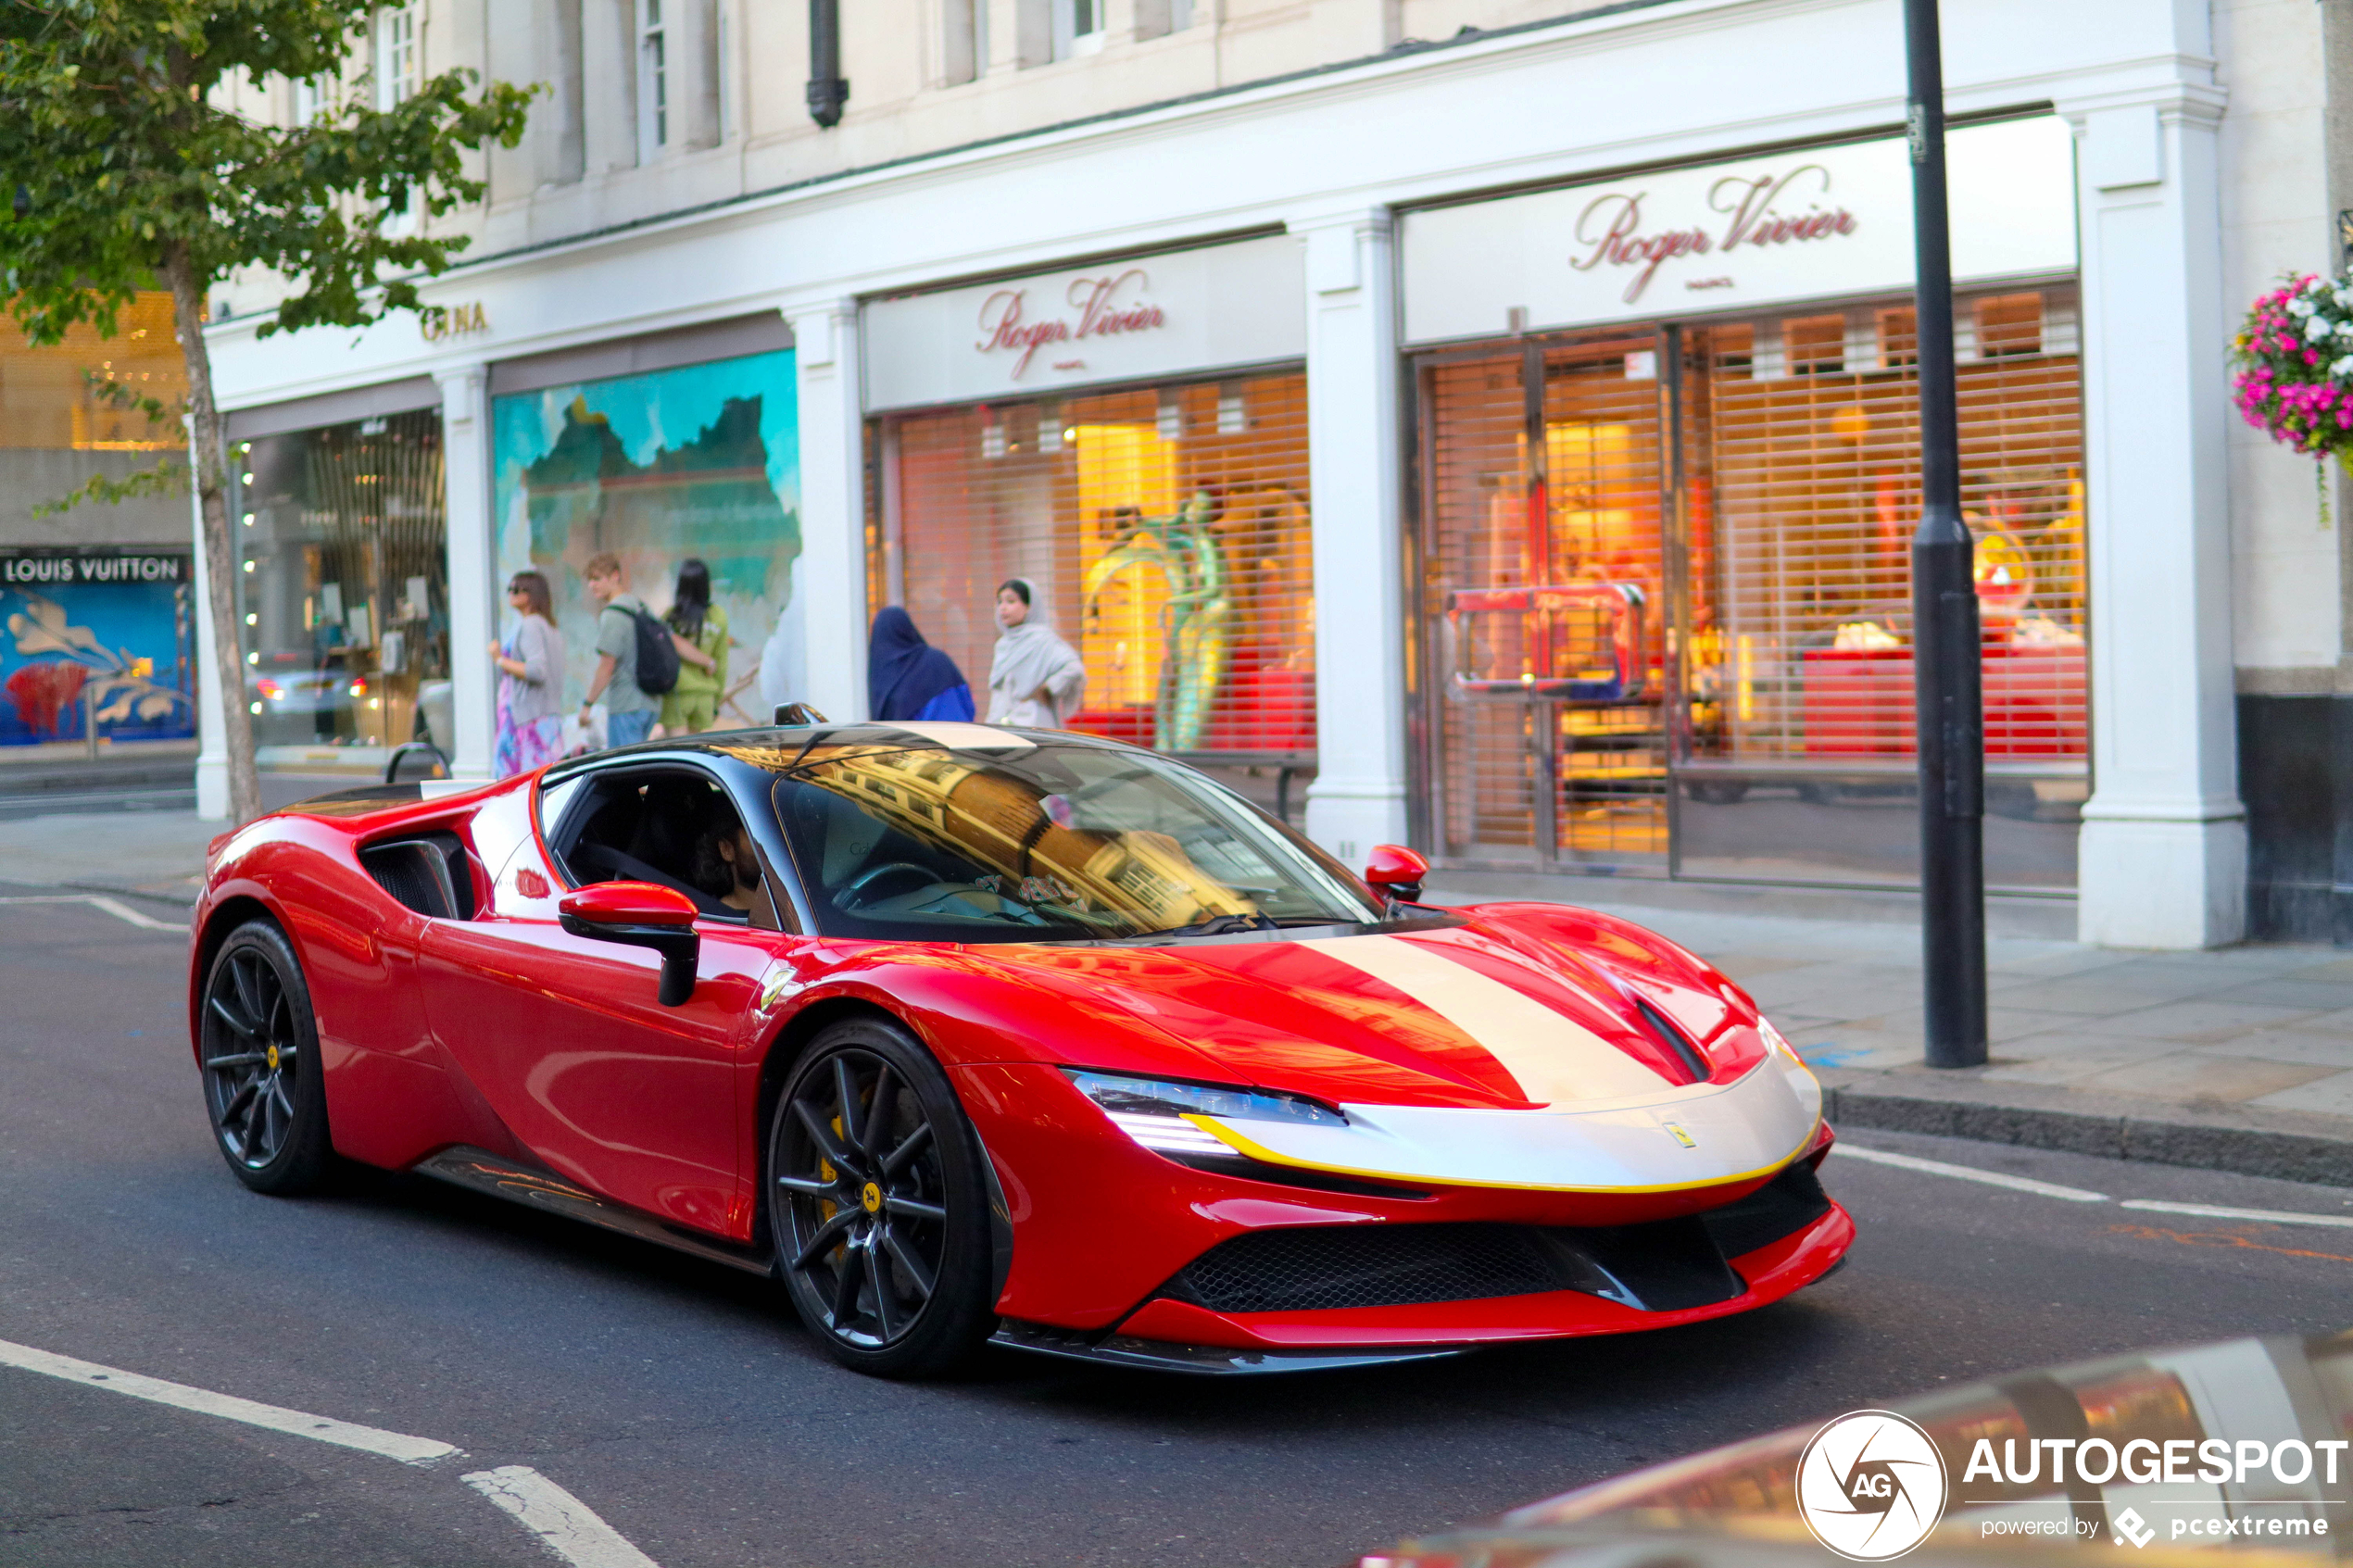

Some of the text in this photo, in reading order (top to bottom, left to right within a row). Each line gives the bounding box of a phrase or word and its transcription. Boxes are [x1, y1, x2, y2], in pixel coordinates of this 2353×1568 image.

[1568, 164, 1857, 304] Roger Vivier
[975, 268, 1165, 380] Roger Vivier
[5, 558, 179, 582] LOUIS VUITTON
